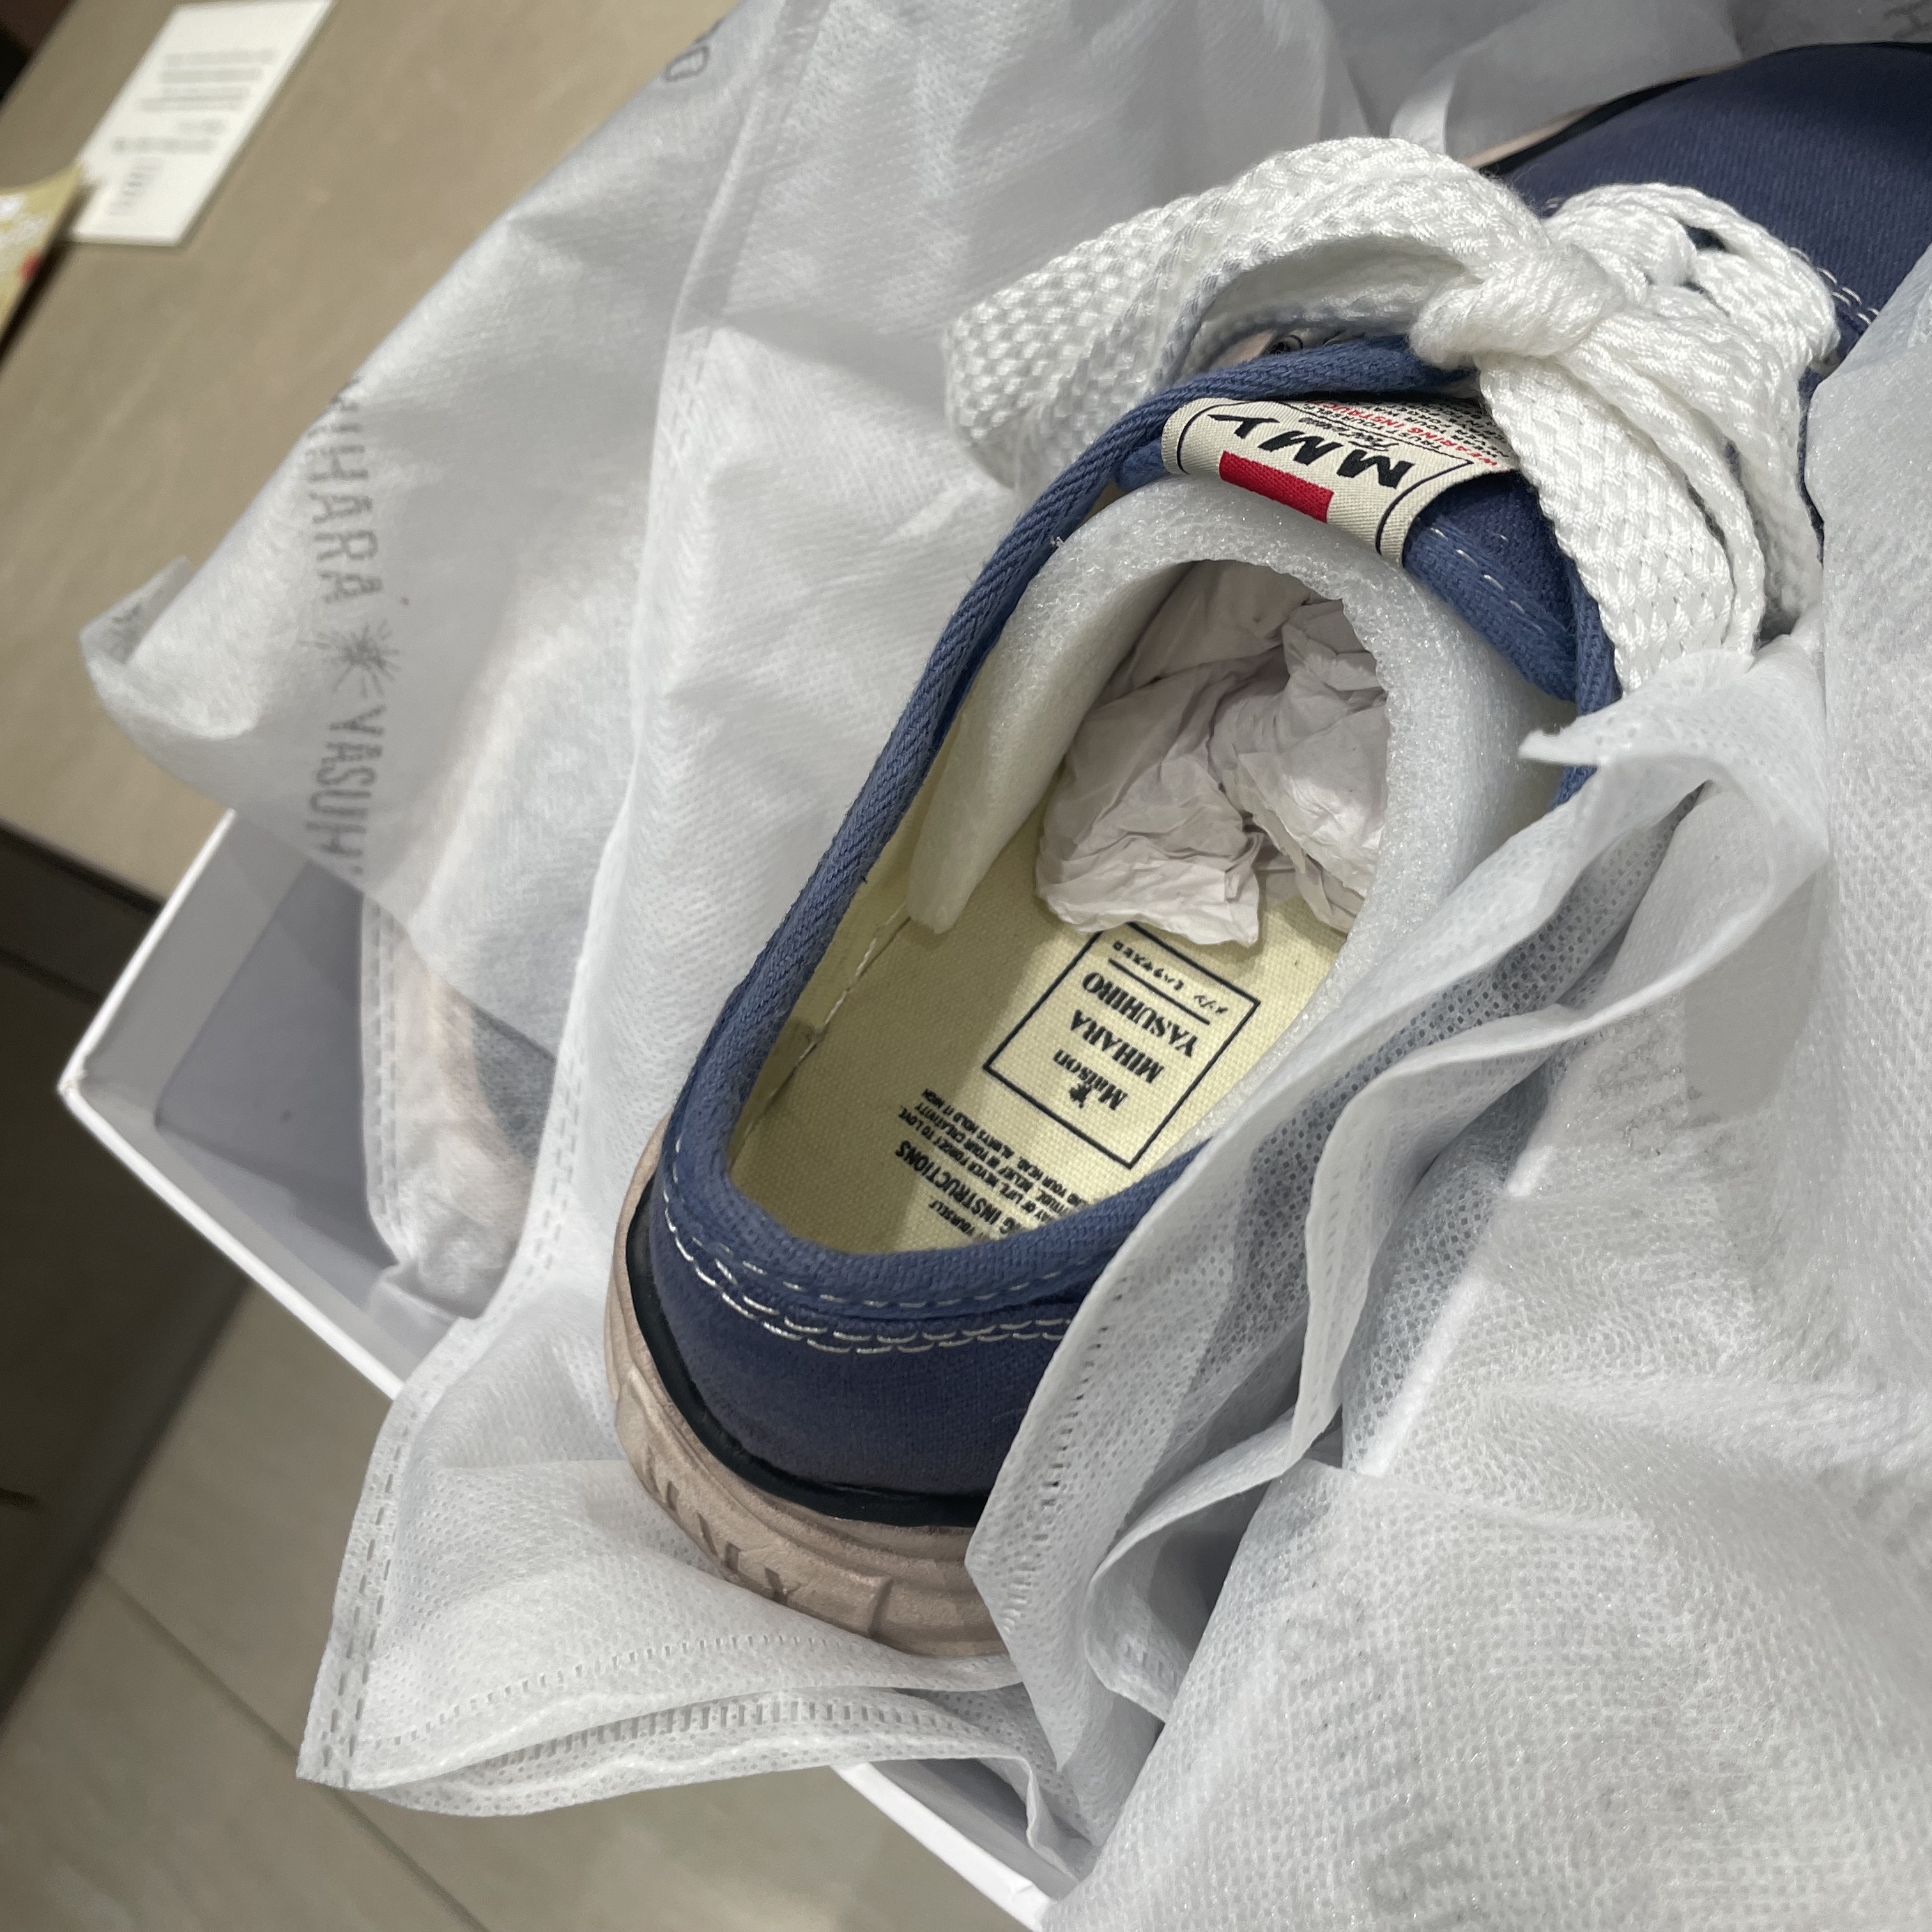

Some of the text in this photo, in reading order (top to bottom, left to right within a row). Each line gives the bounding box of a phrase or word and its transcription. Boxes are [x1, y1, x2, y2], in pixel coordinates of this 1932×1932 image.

[1206, 414, 1414, 489] MMY
[1407, 426, 1498, 466] WEARING
[305, 703, 387, 876] YASUH
[1070, 1009, 1164, 1084] MIHARA
[1082, 972, 1197, 1057] YASUHIRO
[1052, 1048, 1130, 1111] Maison
[921, 1126, 934, 1140] TO
[894, 1140, 1001, 1225] INSTRUCTIONS
